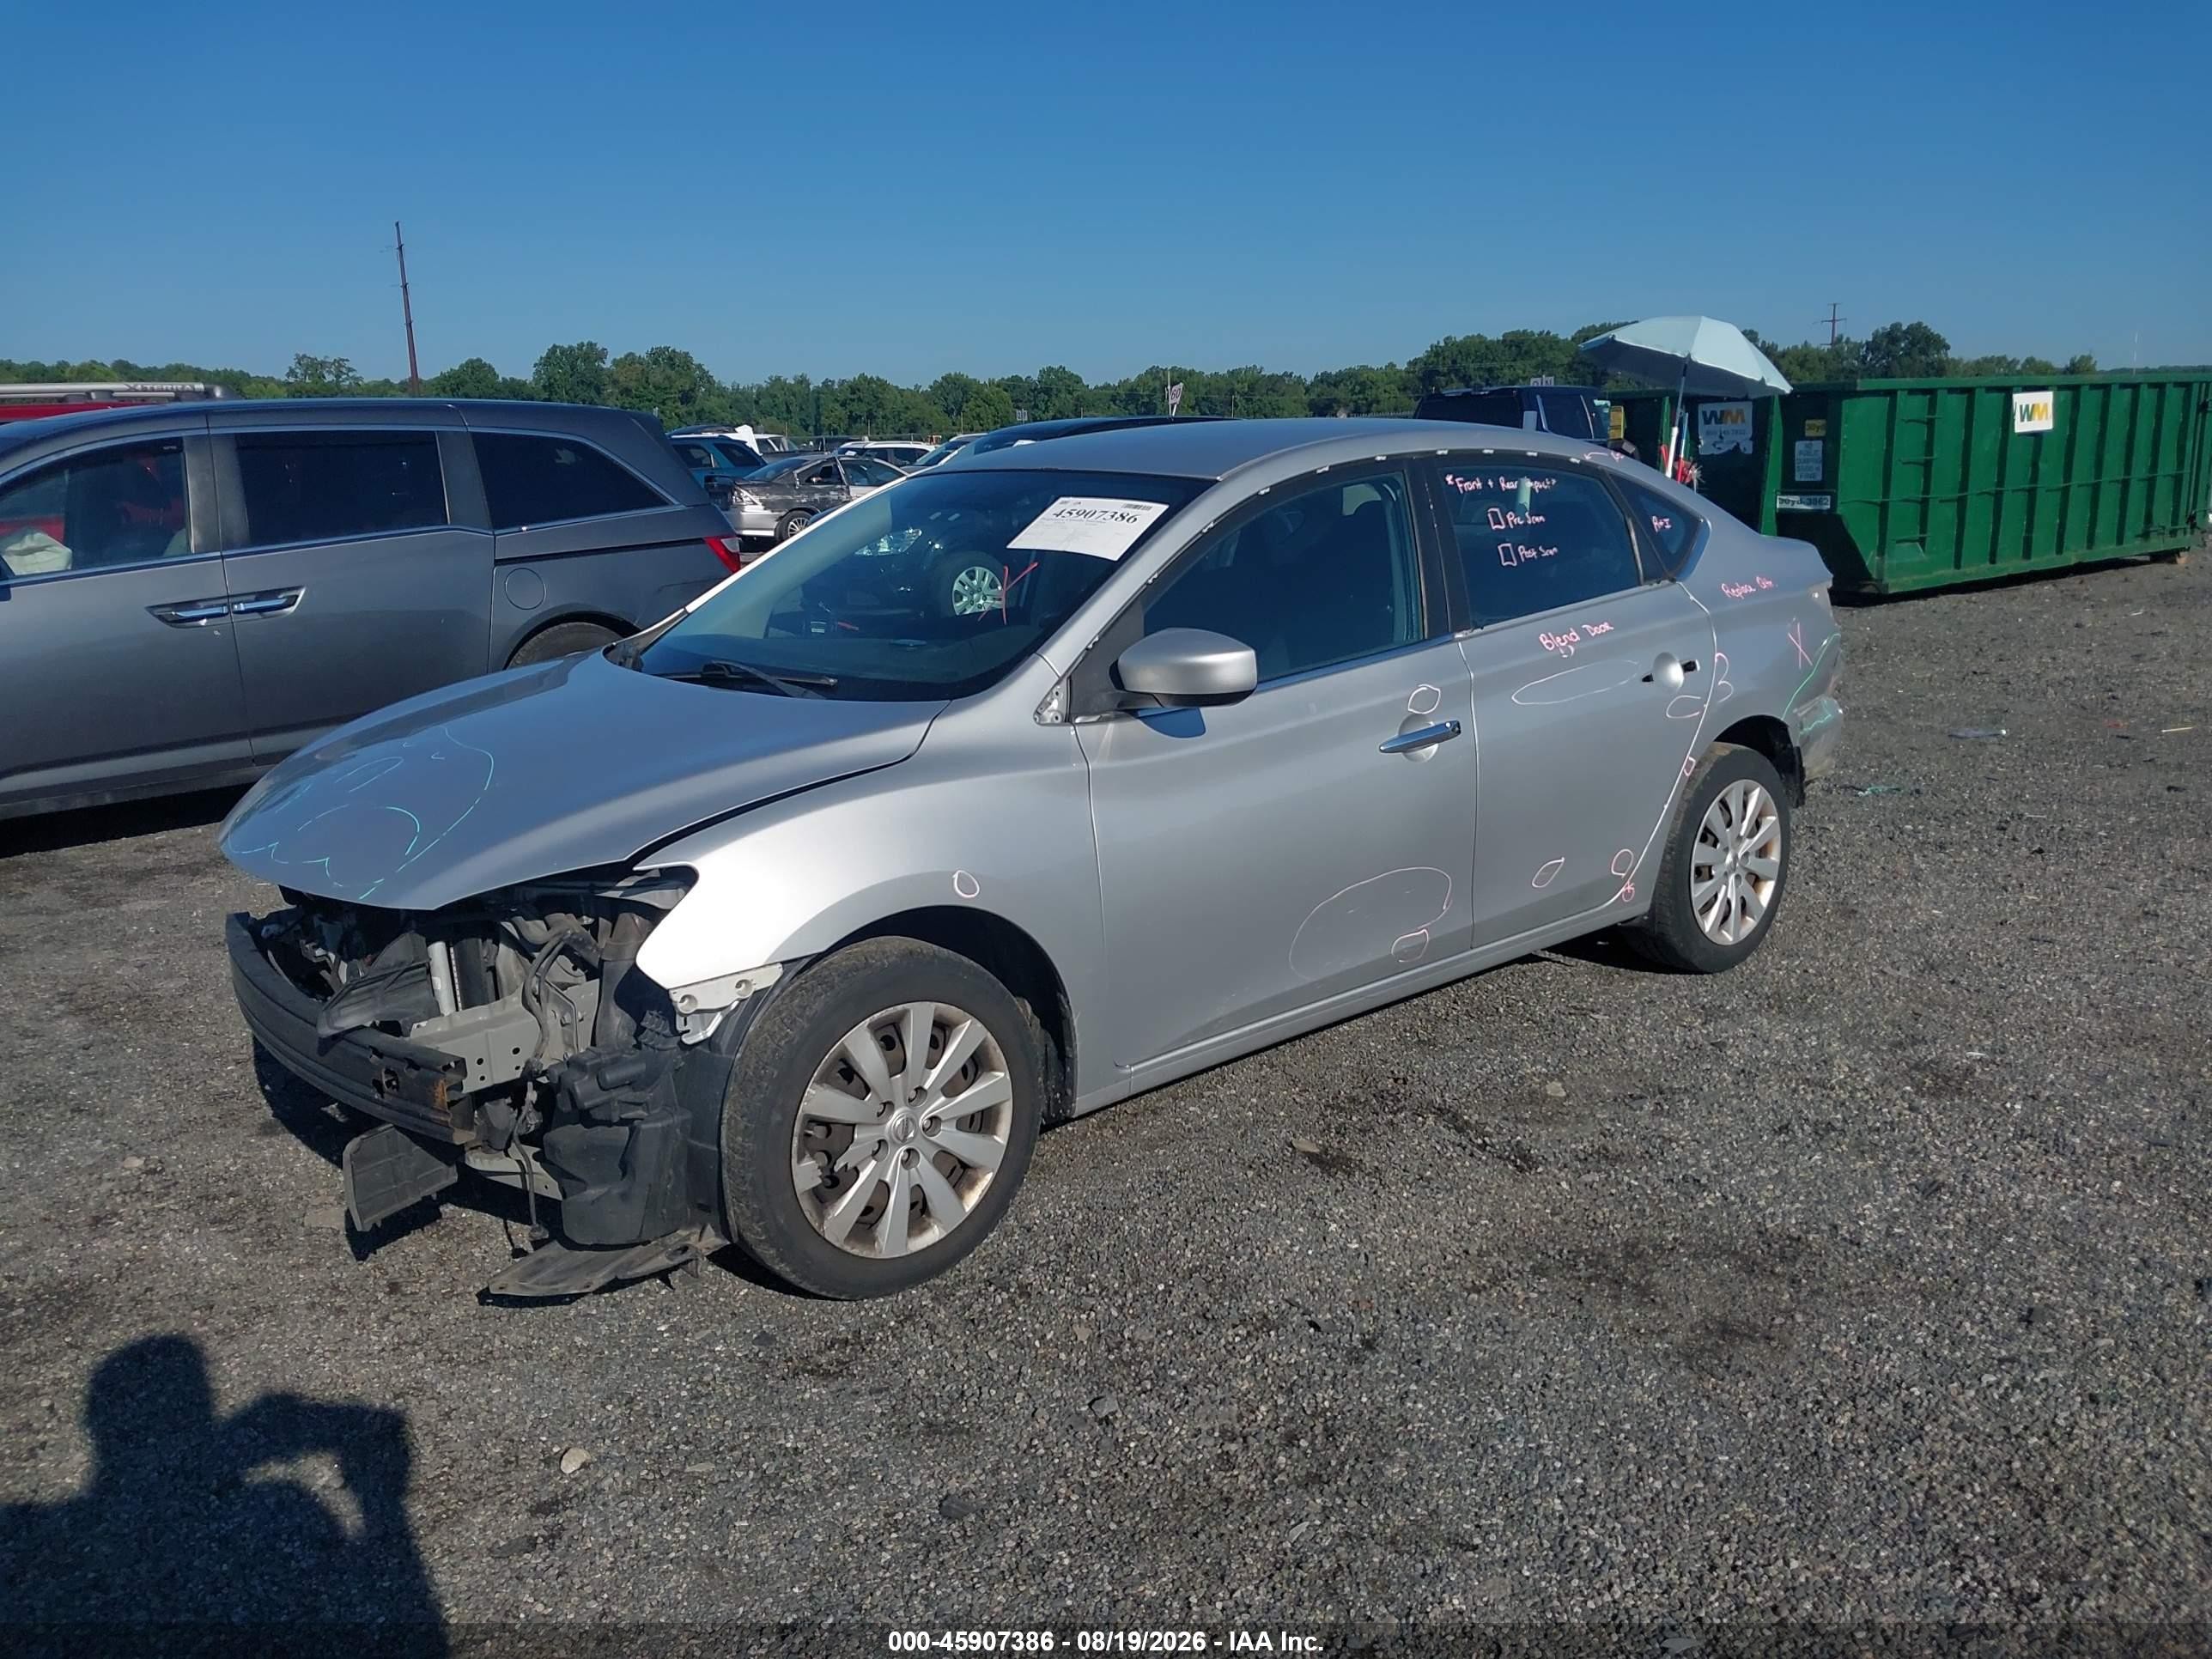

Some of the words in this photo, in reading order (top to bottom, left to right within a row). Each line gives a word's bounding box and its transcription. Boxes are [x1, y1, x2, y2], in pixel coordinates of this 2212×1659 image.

[1702, 408, 1746, 425] WM
[2020, 403, 2049, 422] WM
[1053, 507, 1138, 524] 45907386
[1538, 627, 1581, 651] Blend
